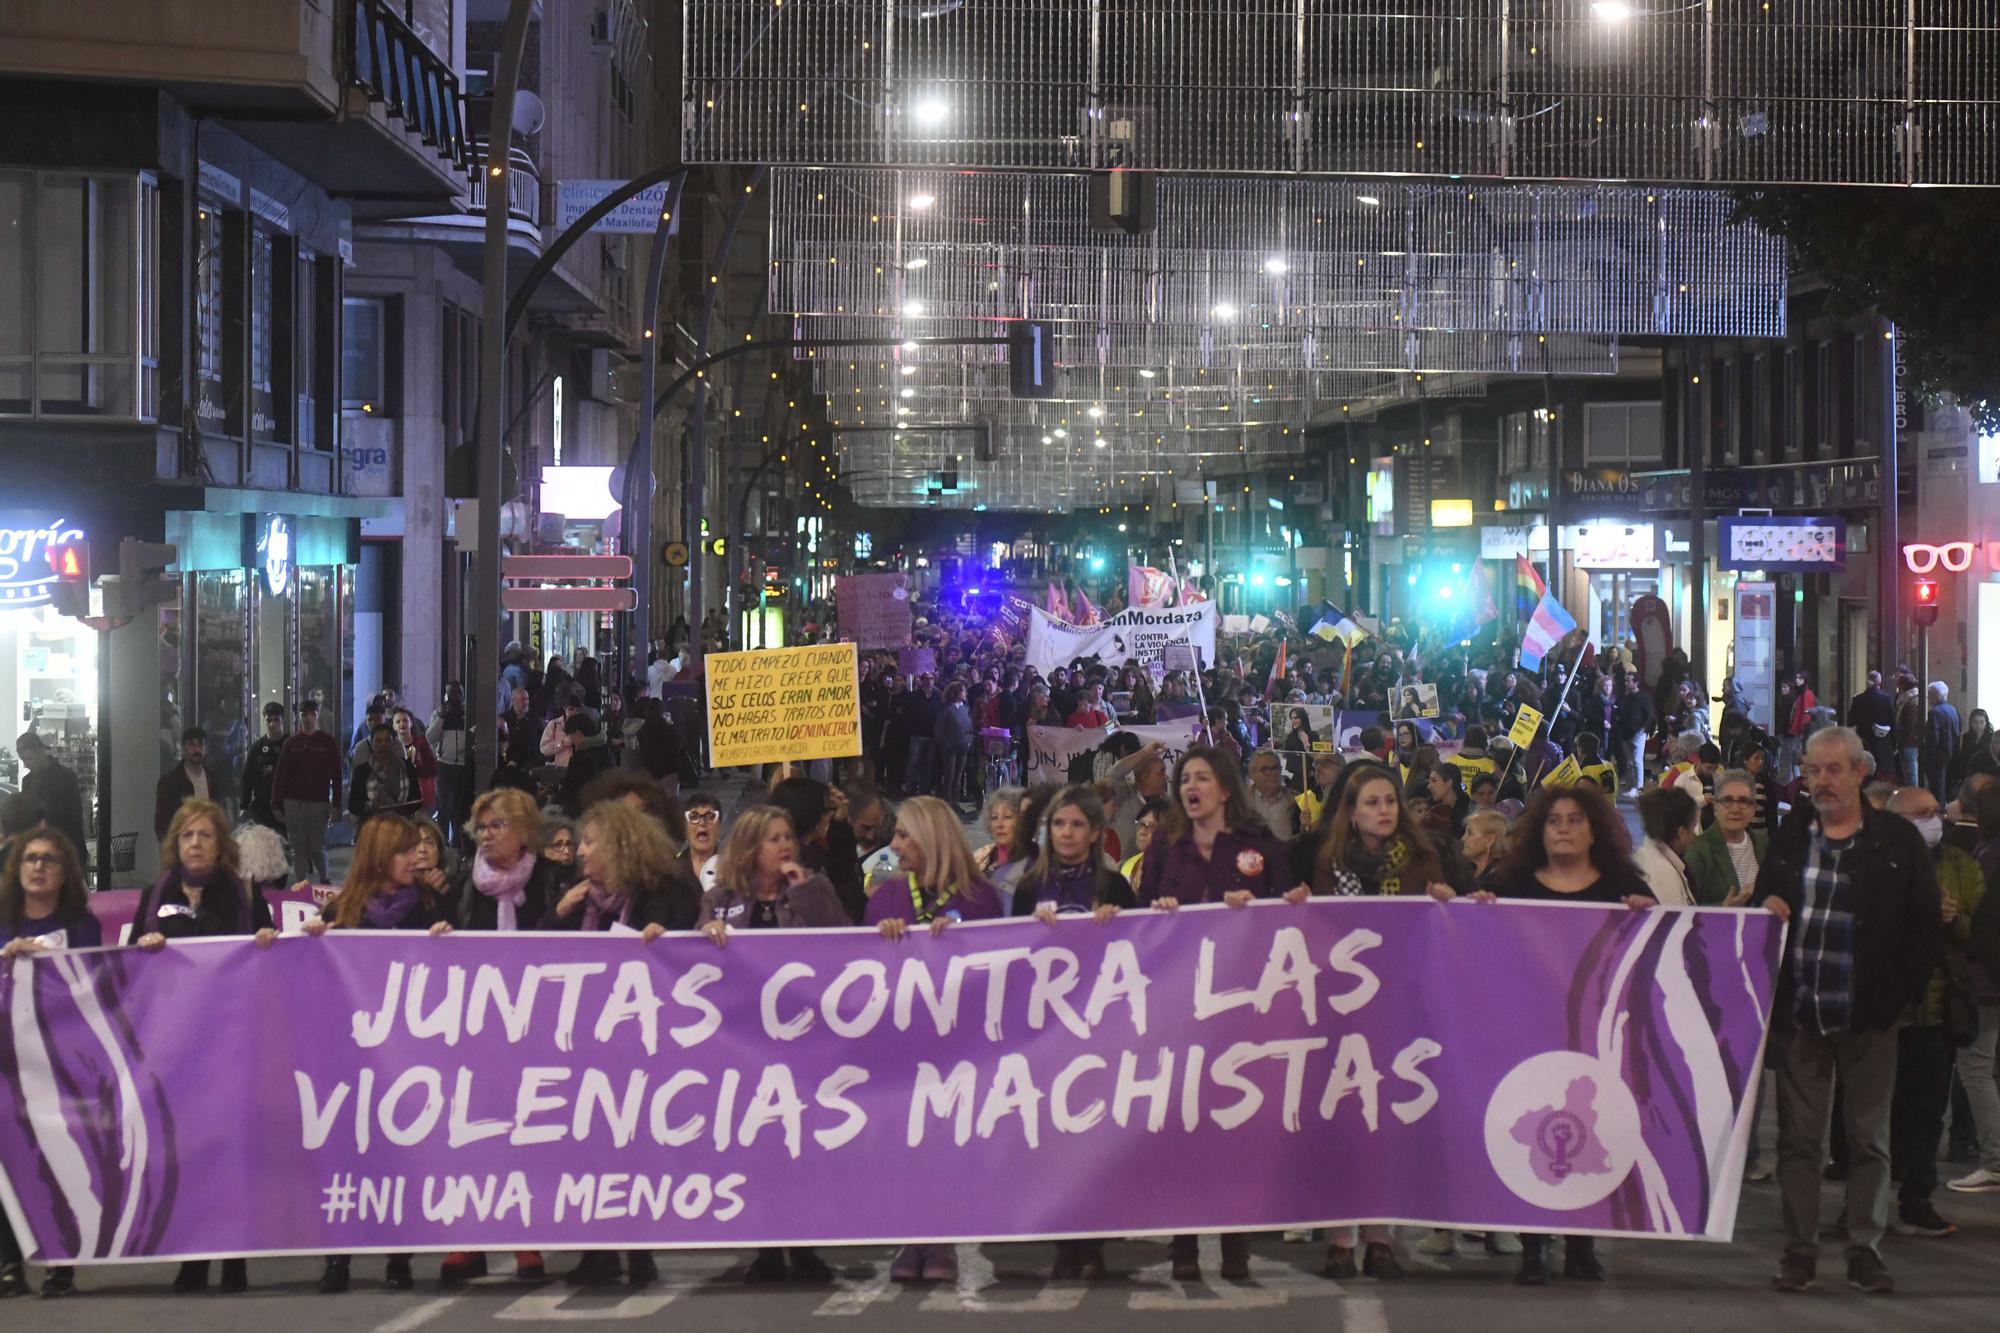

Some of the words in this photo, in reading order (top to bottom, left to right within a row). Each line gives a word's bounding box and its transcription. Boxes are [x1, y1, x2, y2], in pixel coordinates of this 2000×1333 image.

[1135, 633, 1169, 641] CONTRA
[713, 658, 747, 674] TODO
[805, 649, 853, 668] CUANDO
[712, 678, 730, 692] ME
[735, 674, 773, 690] HIZO
[780, 670, 823, 687] CREER
[826, 667, 853, 683] QUE
[712, 694, 737, 710] SUS
[780, 688, 813, 705] ERAN
[713, 713, 734, 729] NO
[736, 709, 777, 726] HAGAS
[783, 706, 826, 722] TRATOS
[829, 702, 856, 719] CON
[713, 732, 727, 747] EL
[350, 960, 723, 1056] JUNTAS
[760, 939, 1152, 1041] CONTRA
[1193, 927, 1383, 1026] LAS
[294, 1063, 870, 1159] VIOLENCIAS
[907, 1032, 1442, 1149] MACHISTAS
[320, 1172, 406, 1226] #NI
[422, 1171, 533, 1228] UNA
[553, 1172, 747, 1224] MENOS
